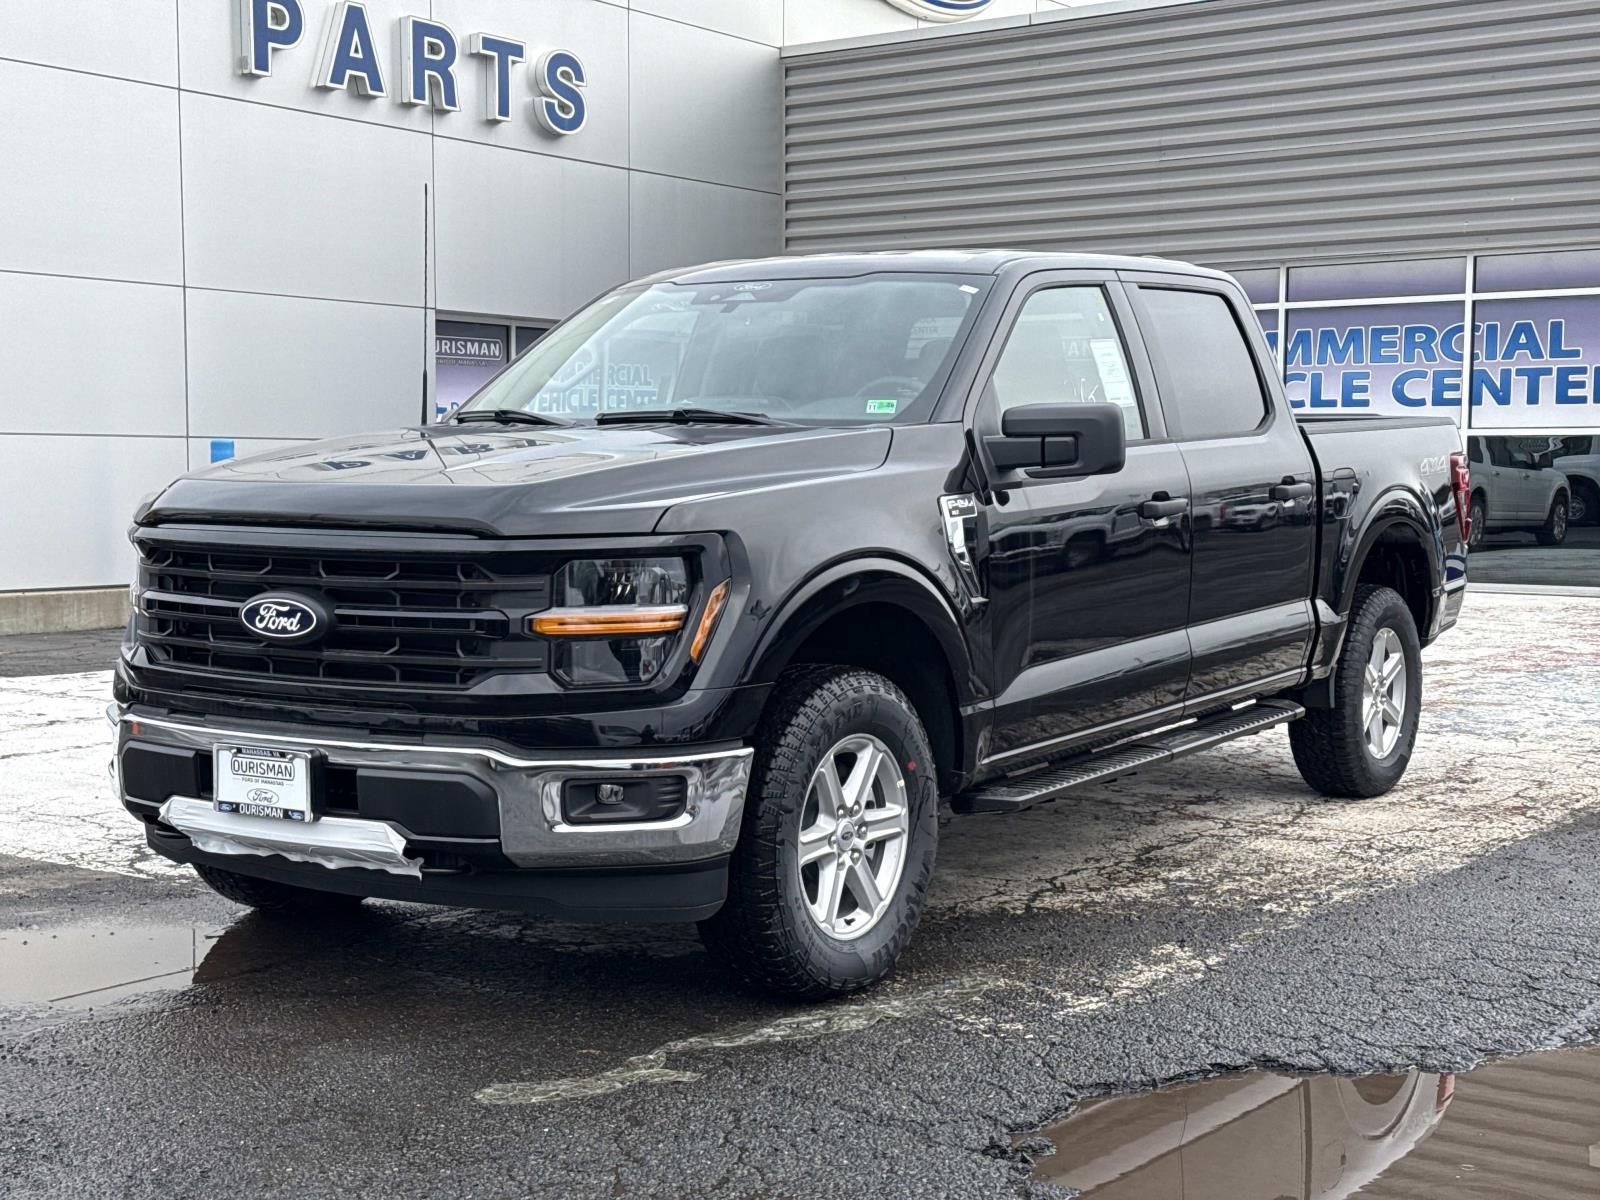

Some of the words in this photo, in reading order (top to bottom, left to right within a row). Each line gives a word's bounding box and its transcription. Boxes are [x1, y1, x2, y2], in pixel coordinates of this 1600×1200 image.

[243, 0, 588, 136] PARTS
[1391, 366, 1600, 407] CENTE
[255, 603, 302, 632] Ford
[232, 758, 293, 778] OURISMAN
[252, 788, 274, 804] Ford
[239, 803, 284, 819] OURISMAN
